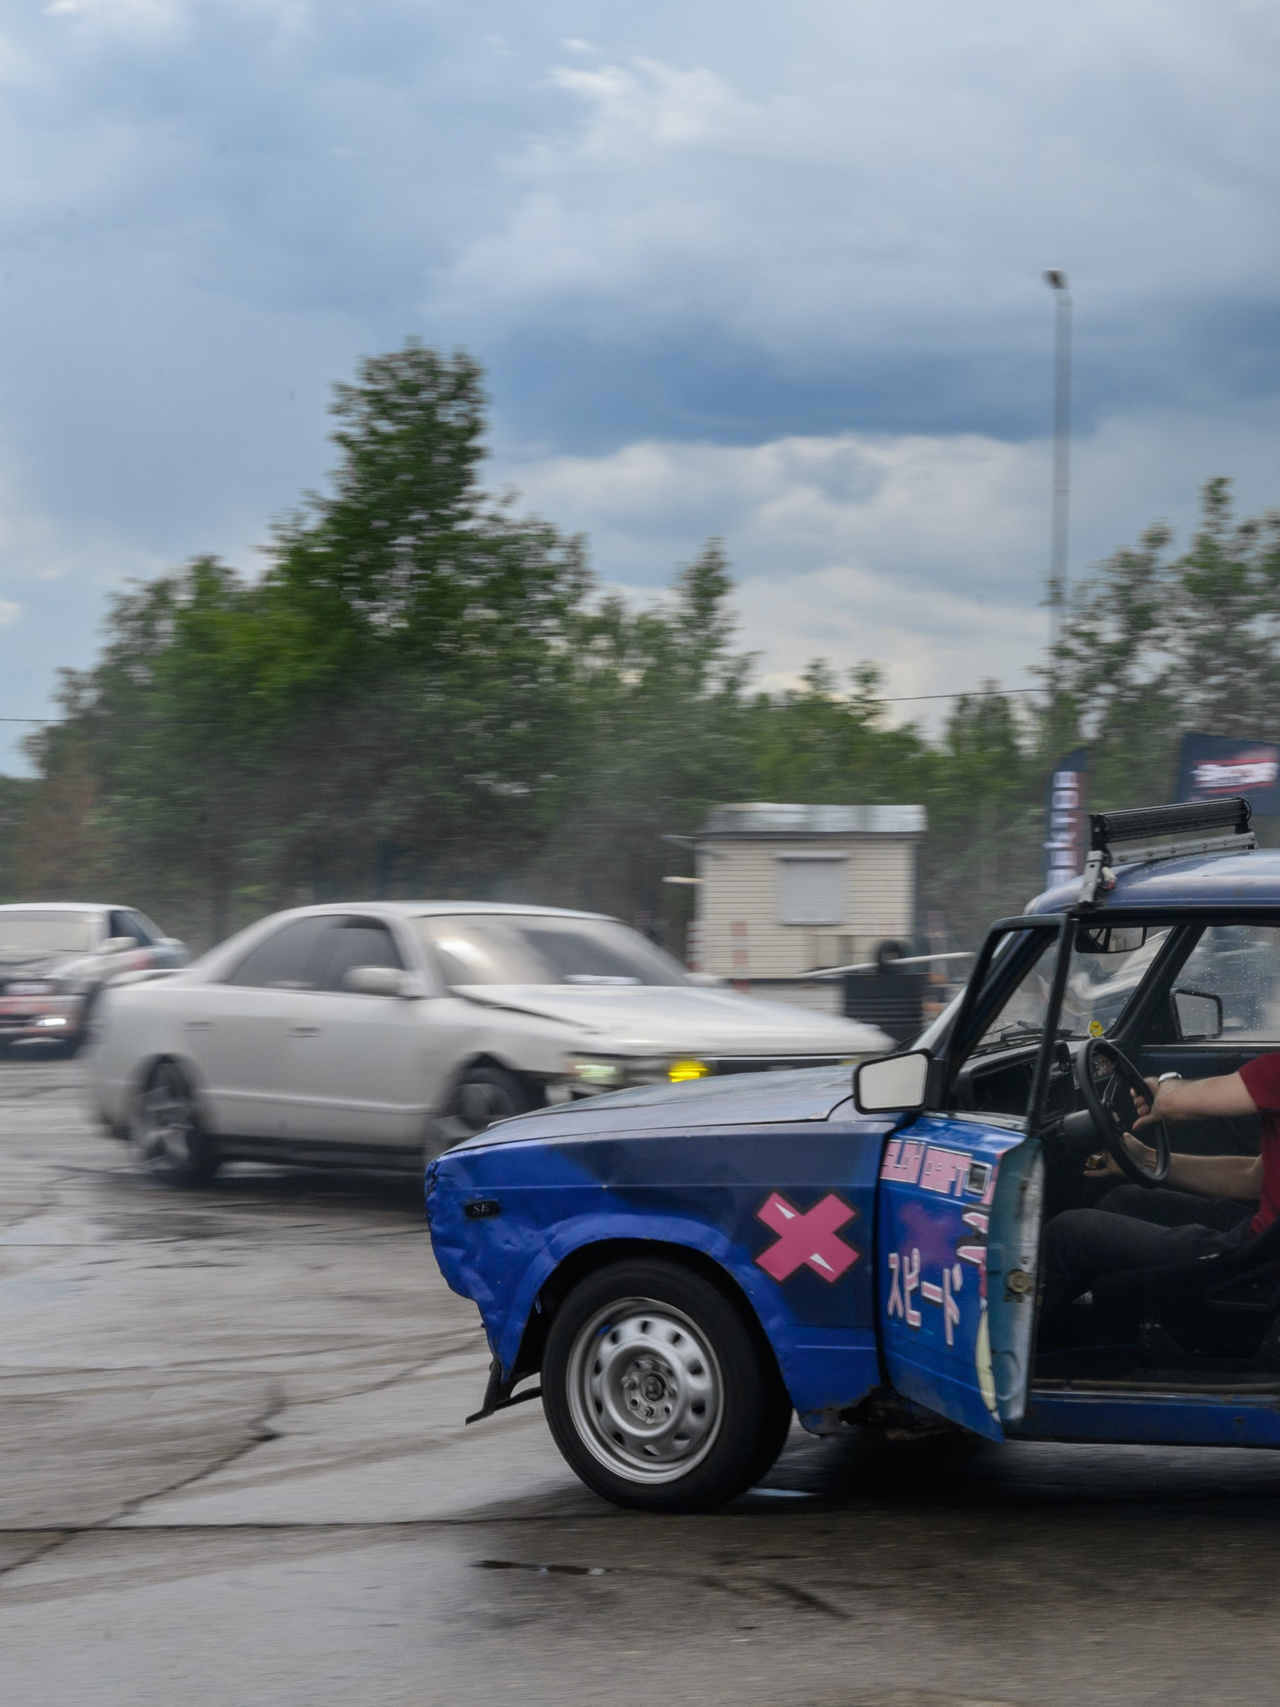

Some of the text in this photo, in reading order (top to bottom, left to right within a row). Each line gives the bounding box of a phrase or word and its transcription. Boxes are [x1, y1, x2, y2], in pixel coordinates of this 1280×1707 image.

[473, 1202, 490, 1214] SE
[887, 1247, 964, 1347] スピード
